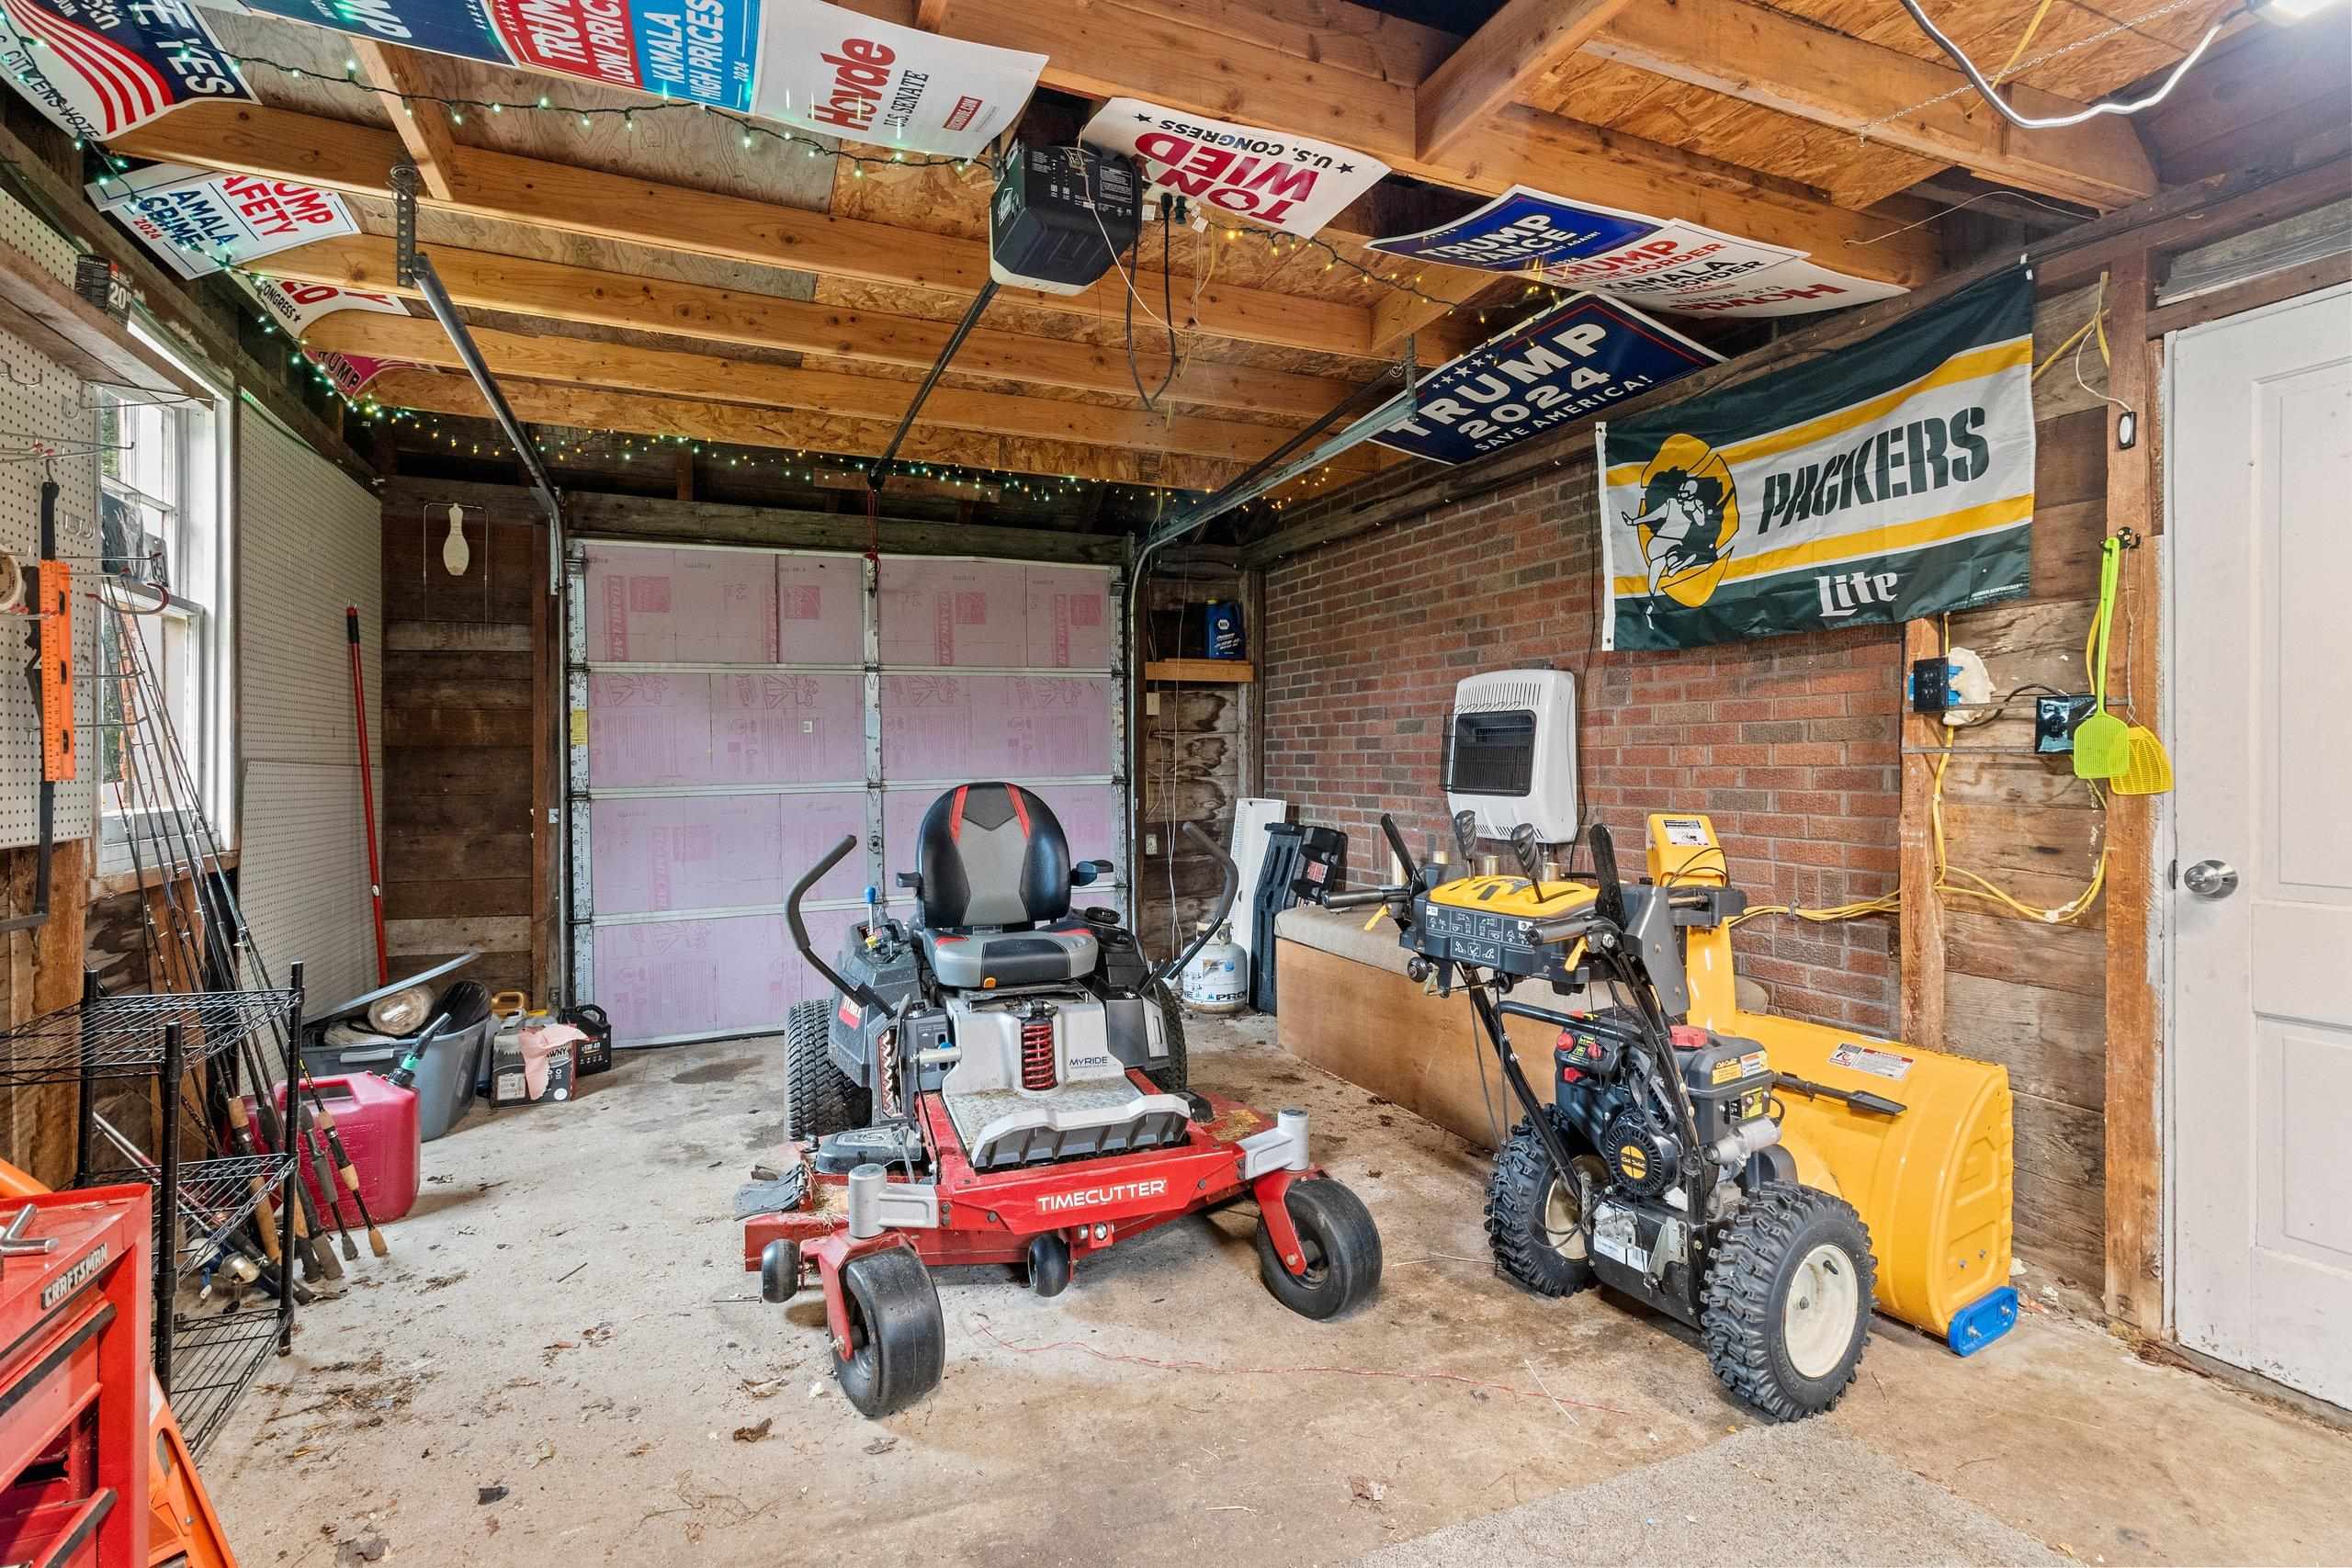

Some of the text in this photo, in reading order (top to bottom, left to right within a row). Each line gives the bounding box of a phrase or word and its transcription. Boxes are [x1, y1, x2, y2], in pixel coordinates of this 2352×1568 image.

[155, 38, 236, 96] YES
[593, 46, 636, 85] LOW
[643, 11, 685, 85] KAMALA
[684, 0, 724, 101] HIGH PRICES
[807, 38, 897, 131] Hovde
[890, 69, 930, 115] SENATE
[1135, 131, 1320, 202] WIED
[1158, 118, 1333, 170] U.S. CONGRESS
[131, 219, 163, 241] 2024
[1415, 214, 1552, 259] TRUMP
[1459, 228, 1577, 264] VANCE
[1544, 240, 1679, 279] TRUMP
[1595, 261, 1744, 292] KAMALA
[1630, 243, 1728, 275] BORDER
[1668, 260, 1766, 291] BORDER
[1385, 322, 1607, 437] TRUMP
[1457, 366, 1611, 440] 2024
[1473, 374, 1655, 453] SAVE AMERICA!
[1757, 406, 1991, 536] PACKERS
[1814, 570, 1899, 617] Lite
[1036, 1179, 1166, 1212] TIMECUTTER
[43, 1242, 108, 1308] CRAFTSMAN
